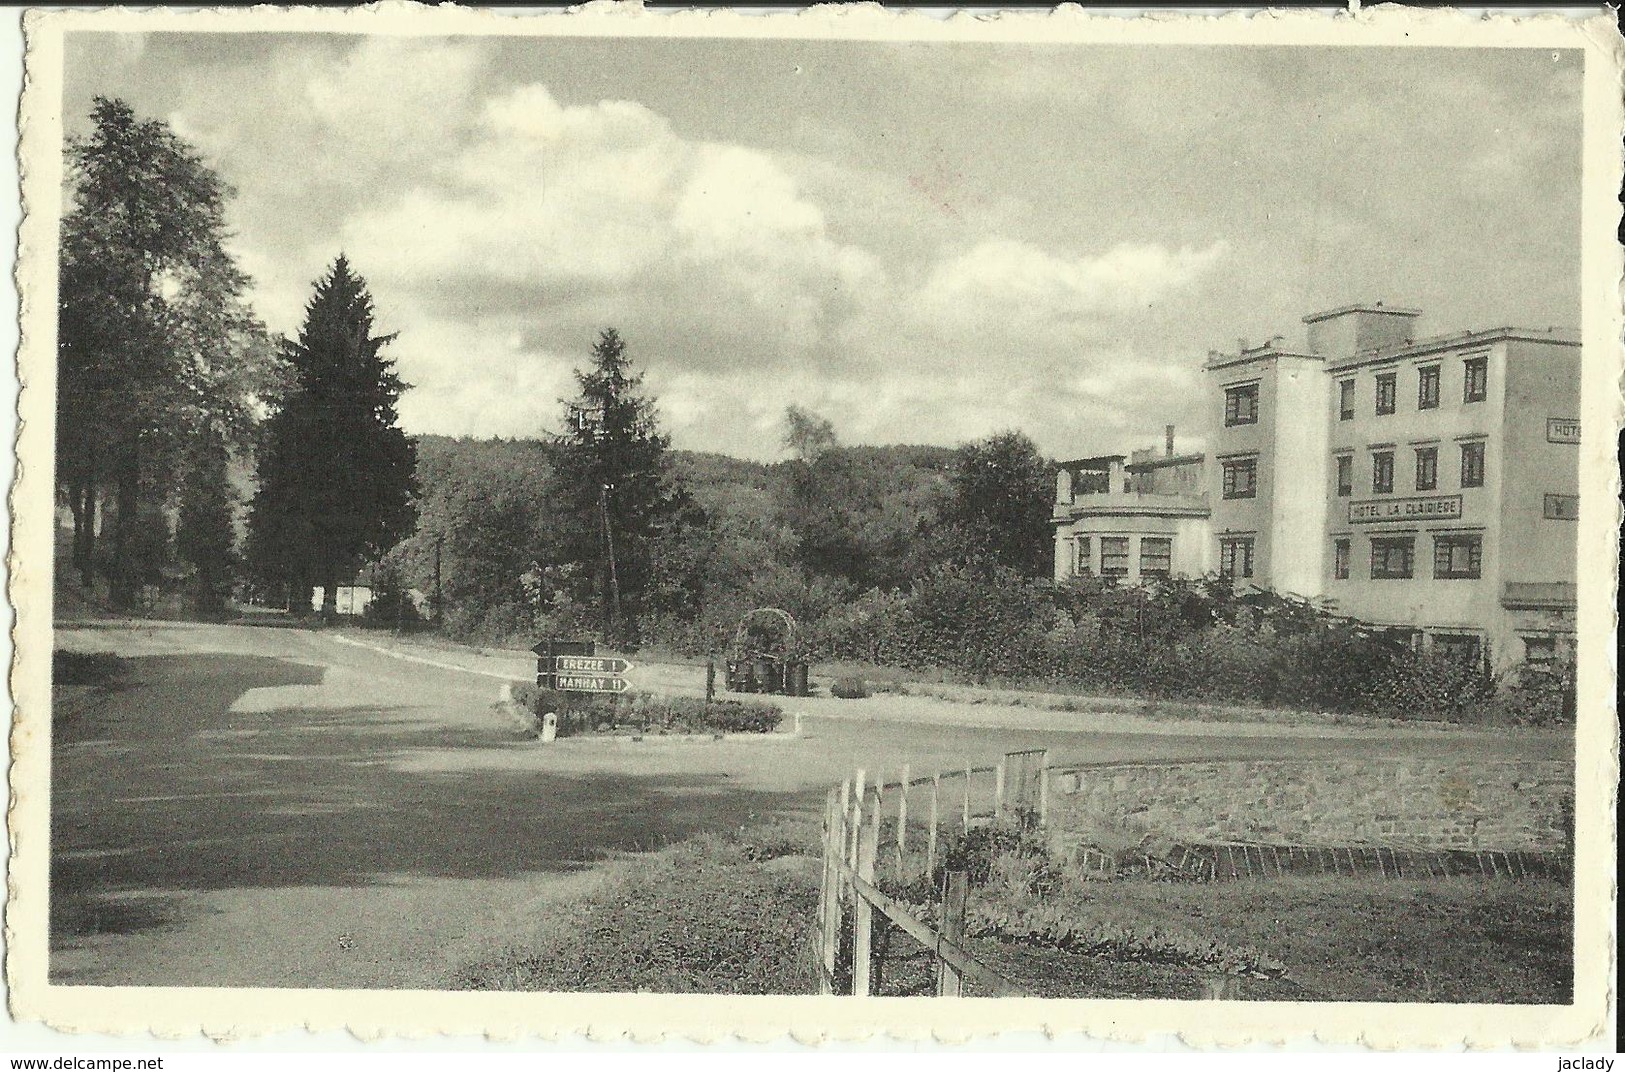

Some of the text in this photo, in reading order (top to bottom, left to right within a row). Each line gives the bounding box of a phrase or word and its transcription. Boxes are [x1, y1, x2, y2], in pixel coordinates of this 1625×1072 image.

[1354, 505, 1380, 517] HOTEL
[1388, 504, 1400, 515] LA
[563, 660, 604, 671] EREZEE
